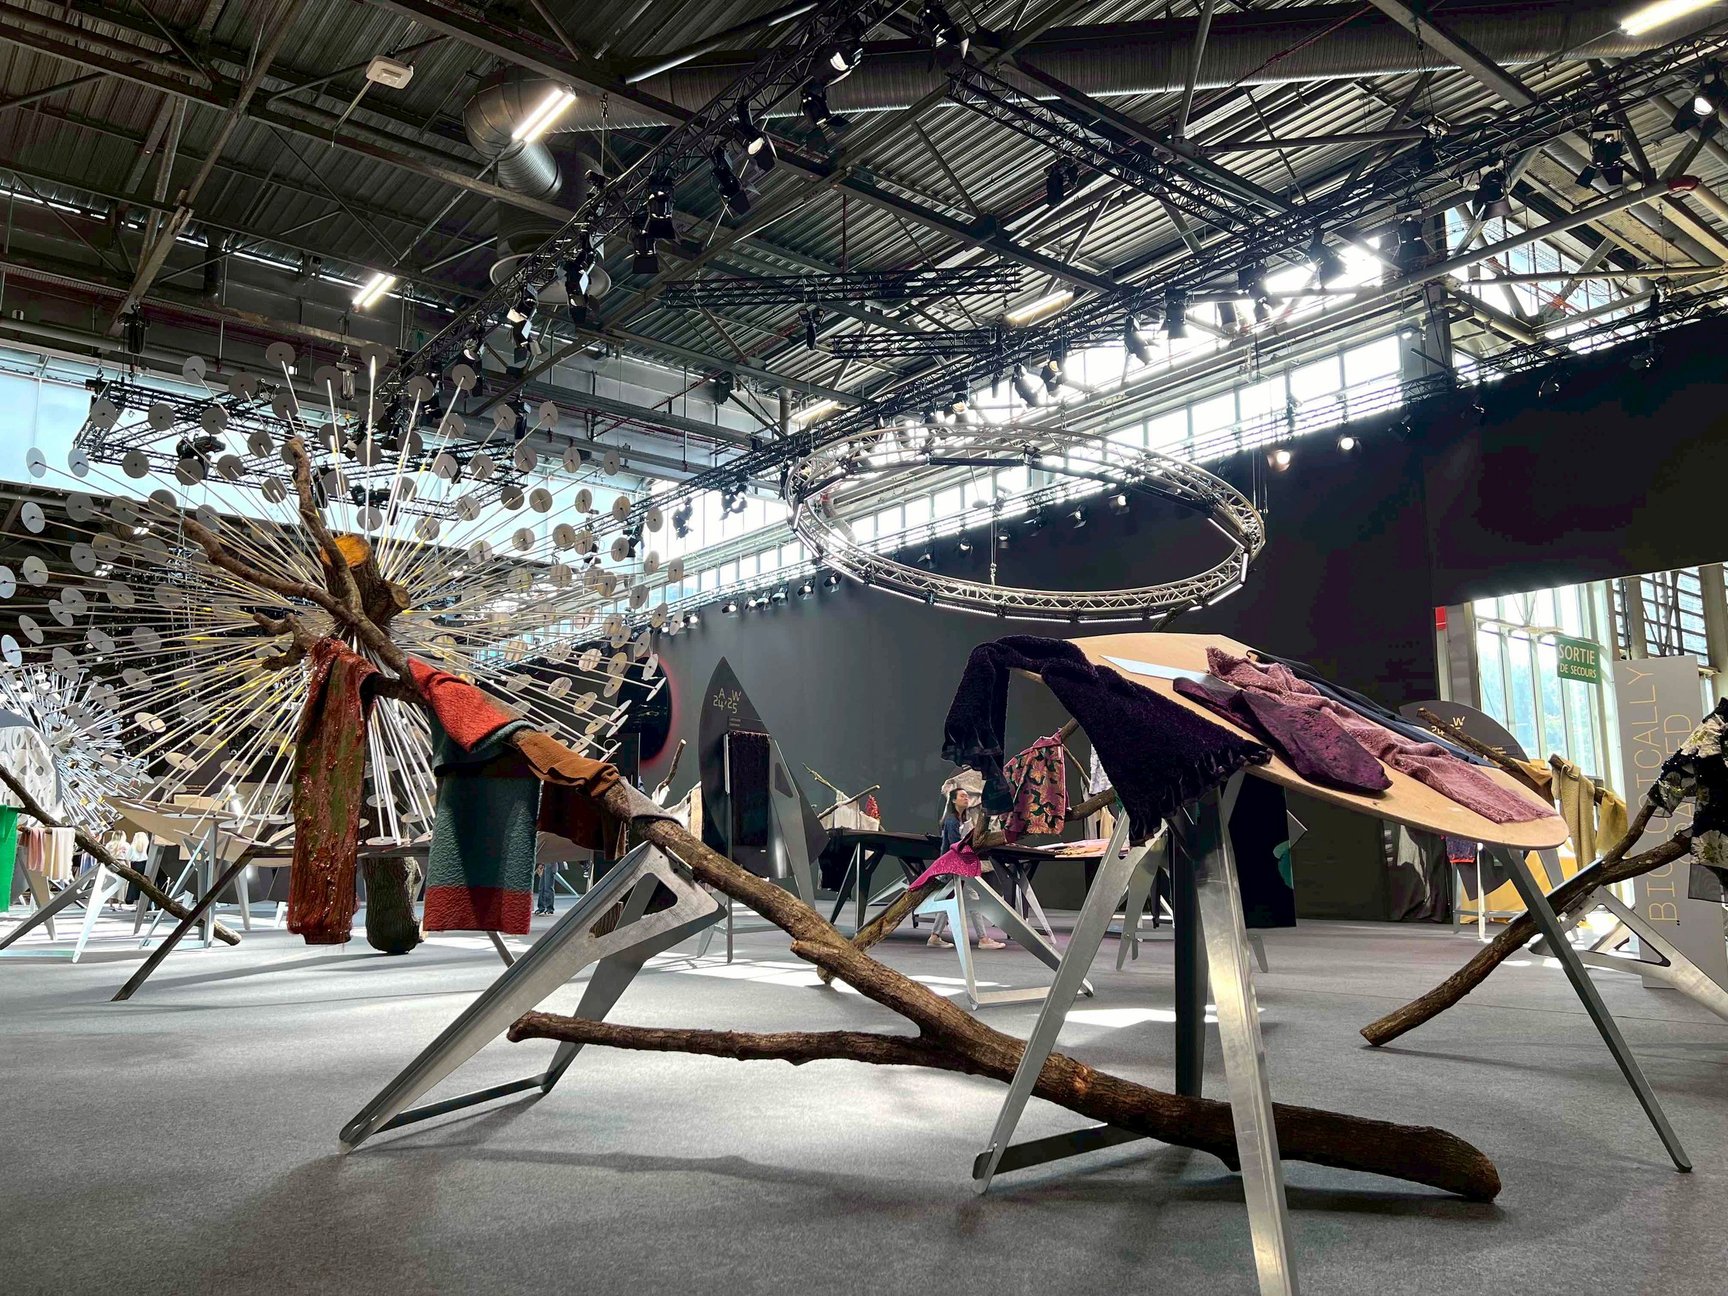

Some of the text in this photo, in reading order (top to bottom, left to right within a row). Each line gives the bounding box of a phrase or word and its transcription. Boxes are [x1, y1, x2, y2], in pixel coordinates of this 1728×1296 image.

[1559, 644, 1595, 665] SORTIE
[1560, 662, 1597, 679] DE SECOURS
